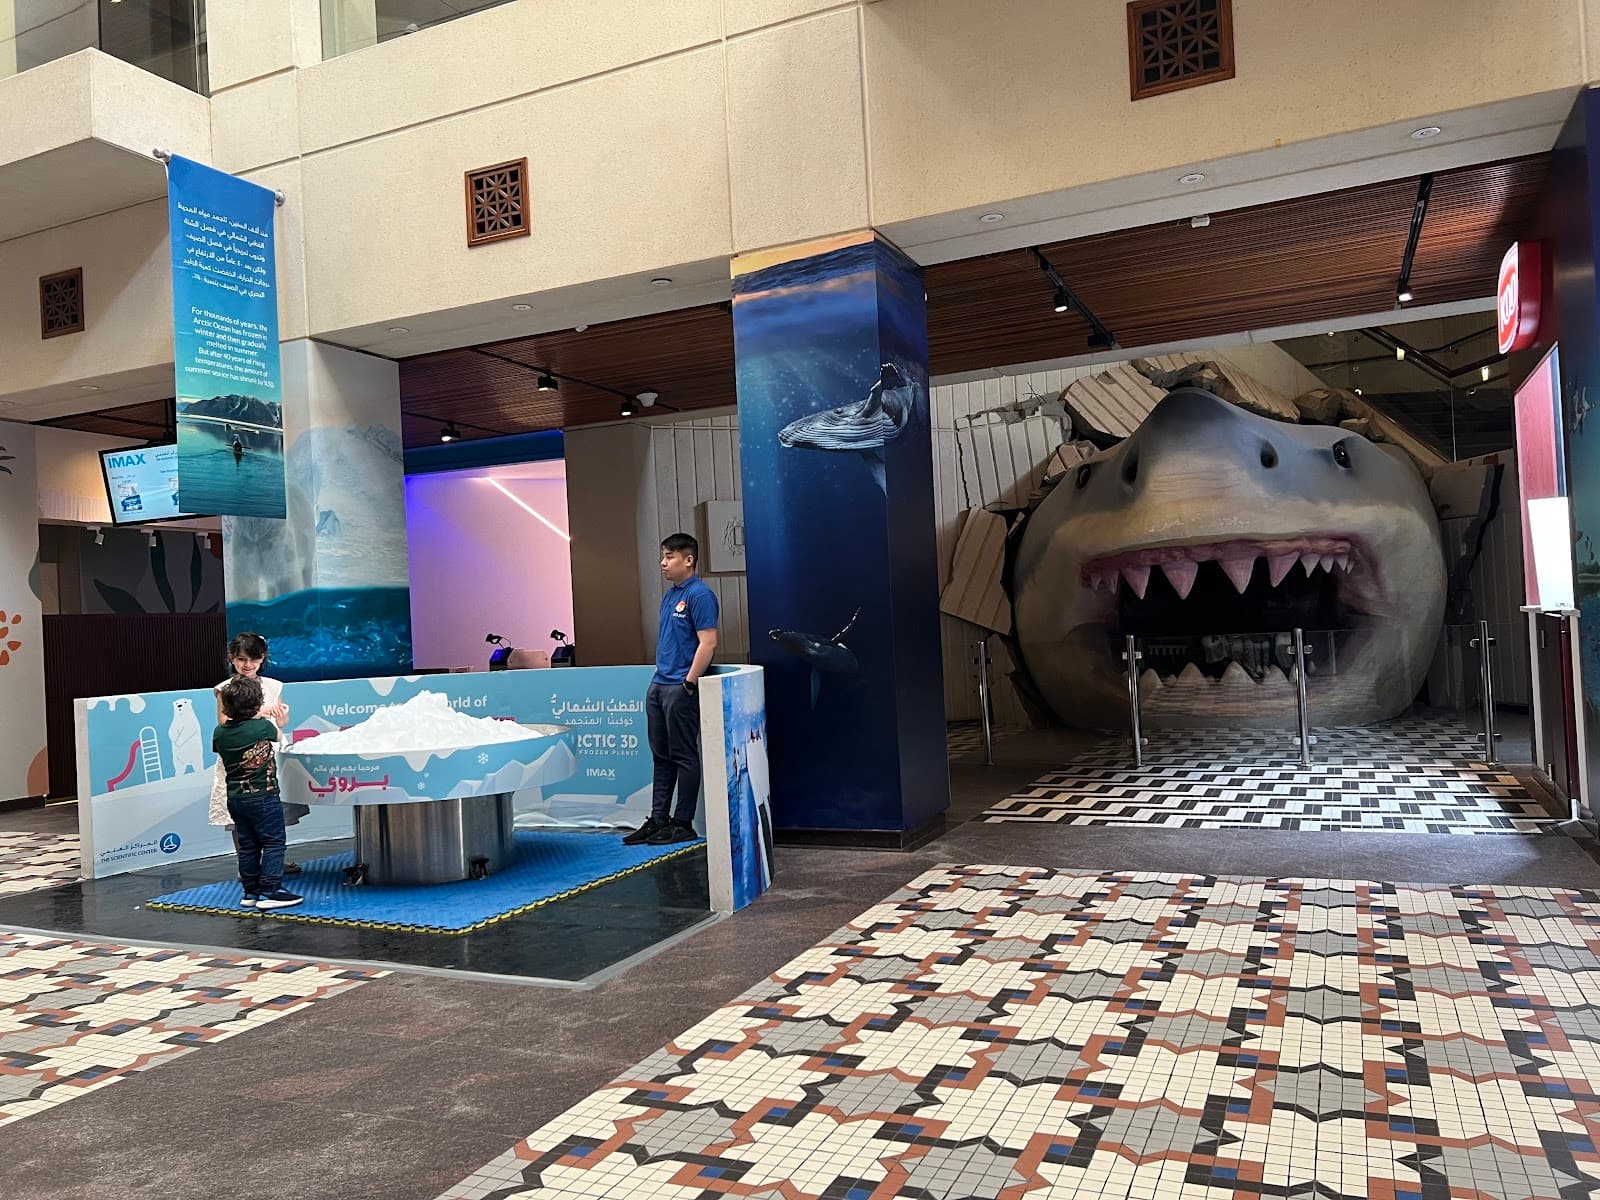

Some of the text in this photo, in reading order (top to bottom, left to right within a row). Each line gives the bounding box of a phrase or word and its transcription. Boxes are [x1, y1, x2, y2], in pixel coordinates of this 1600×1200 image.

[192, 307, 203, 315] For
[204, 309, 232, 324] thousands
[240, 321, 258, 330] years,
[193, 318, 212, 327] Arctic
[213, 320, 231, 332] Ocean
[232, 327, 241, 336] has
[243, 329, 261, 339] frozen
[194, 328, 215, 338] winter
[241, 339, 266, 350] gradually
[207, 341, 227, 350] melted
[195, 357, 233, 370] temperatures,
[244, 367, 263, 376] amount
[199, 347, 209, 355] But
[210, 350, 222, 358] after
[230, 355, 245, 364] years
[253, 359, 265, 369] rising
[185, 366, 211, 374] summer
[230, 373, 239, 381] has
[240, 375, 257, 383] shrunk
[107, 453, 146, 468] IMAX
[447, 695, 487, 708] orld of
[577, 734, 638, 748] CTIC 3D
[586, 768, 615, 777] IMAX
